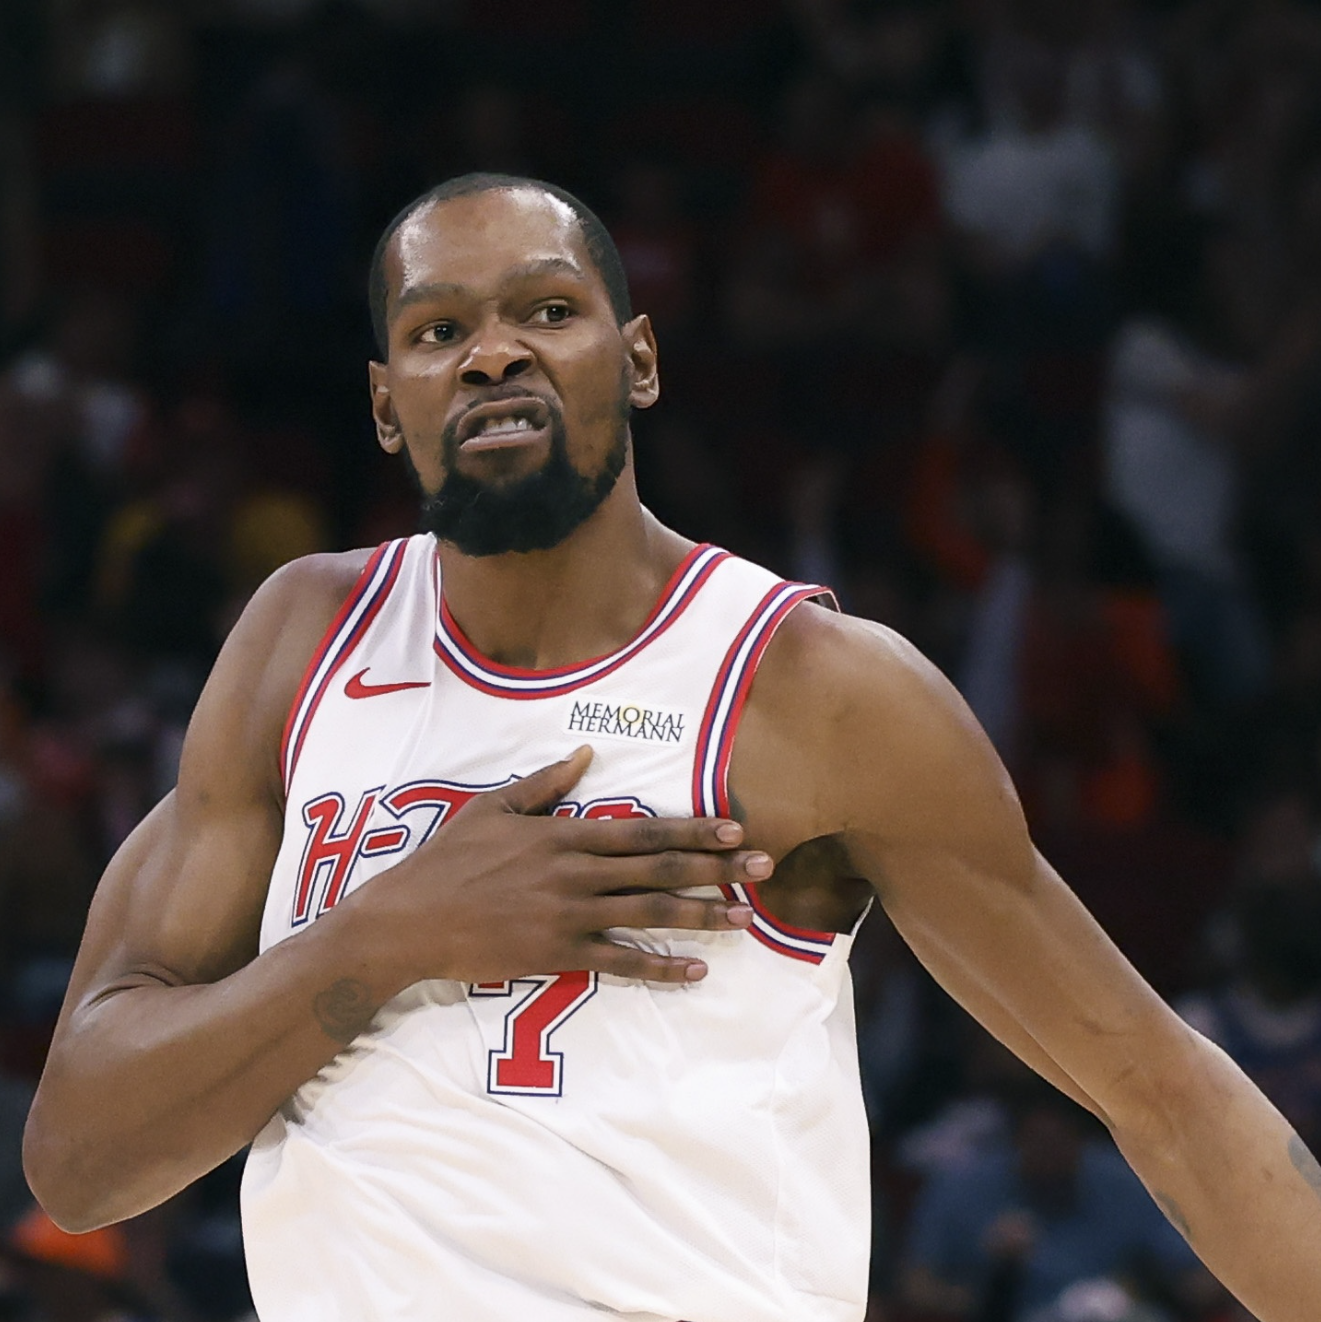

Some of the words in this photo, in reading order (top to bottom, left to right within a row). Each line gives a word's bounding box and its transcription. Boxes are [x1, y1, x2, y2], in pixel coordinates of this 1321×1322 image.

[567, 713, 684, 743] HERMANN
[571, 700, 686, 729] MEMORIAL
[468, 969, 599, 1098] 7
